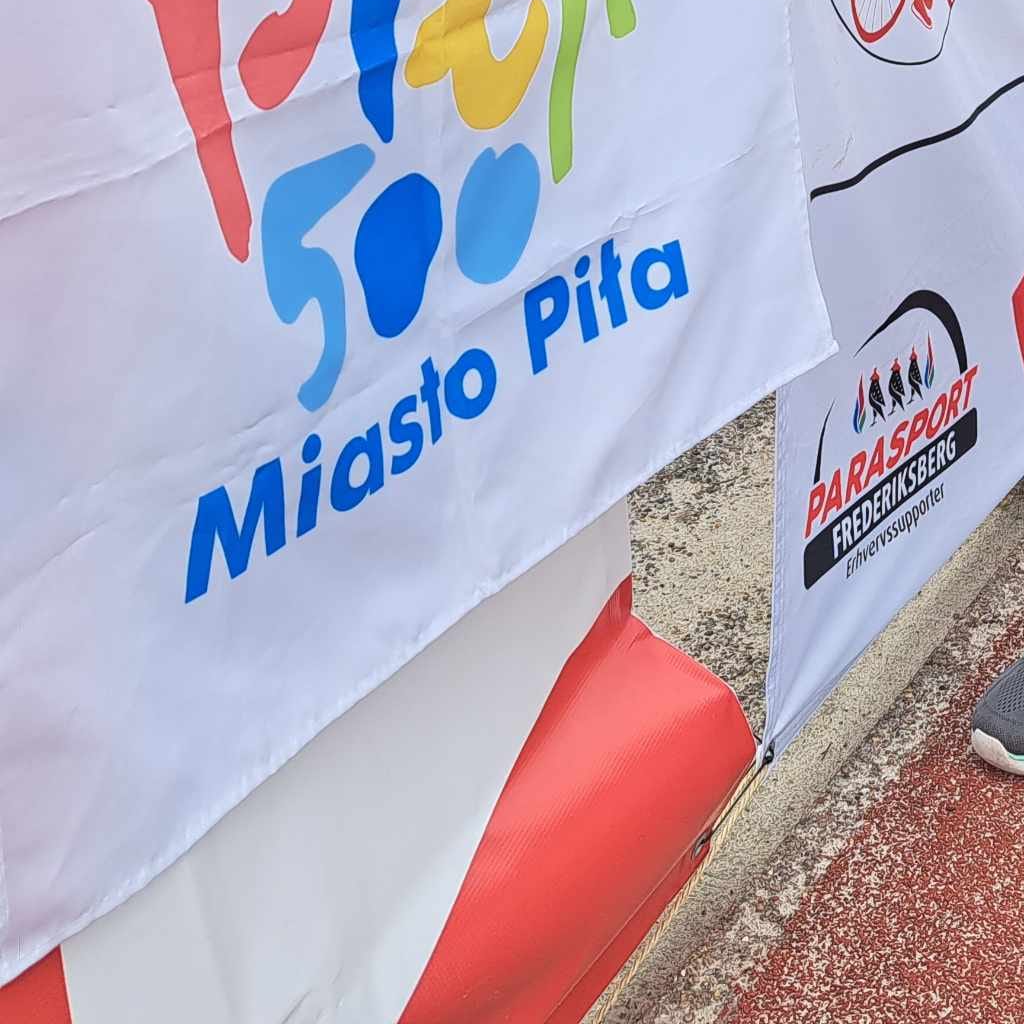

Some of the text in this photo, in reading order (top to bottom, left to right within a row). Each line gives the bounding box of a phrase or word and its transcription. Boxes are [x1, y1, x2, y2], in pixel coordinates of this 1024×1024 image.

[261, 142, 541, 413] 500
[184, 237, 690, 605] Miasto Piła
[804, 364, 978, 539] PARASPORT
[832, 429, 957, 559] FREDERIKSBERG
[846, 482, 945, 579] Erhvervssupporter
